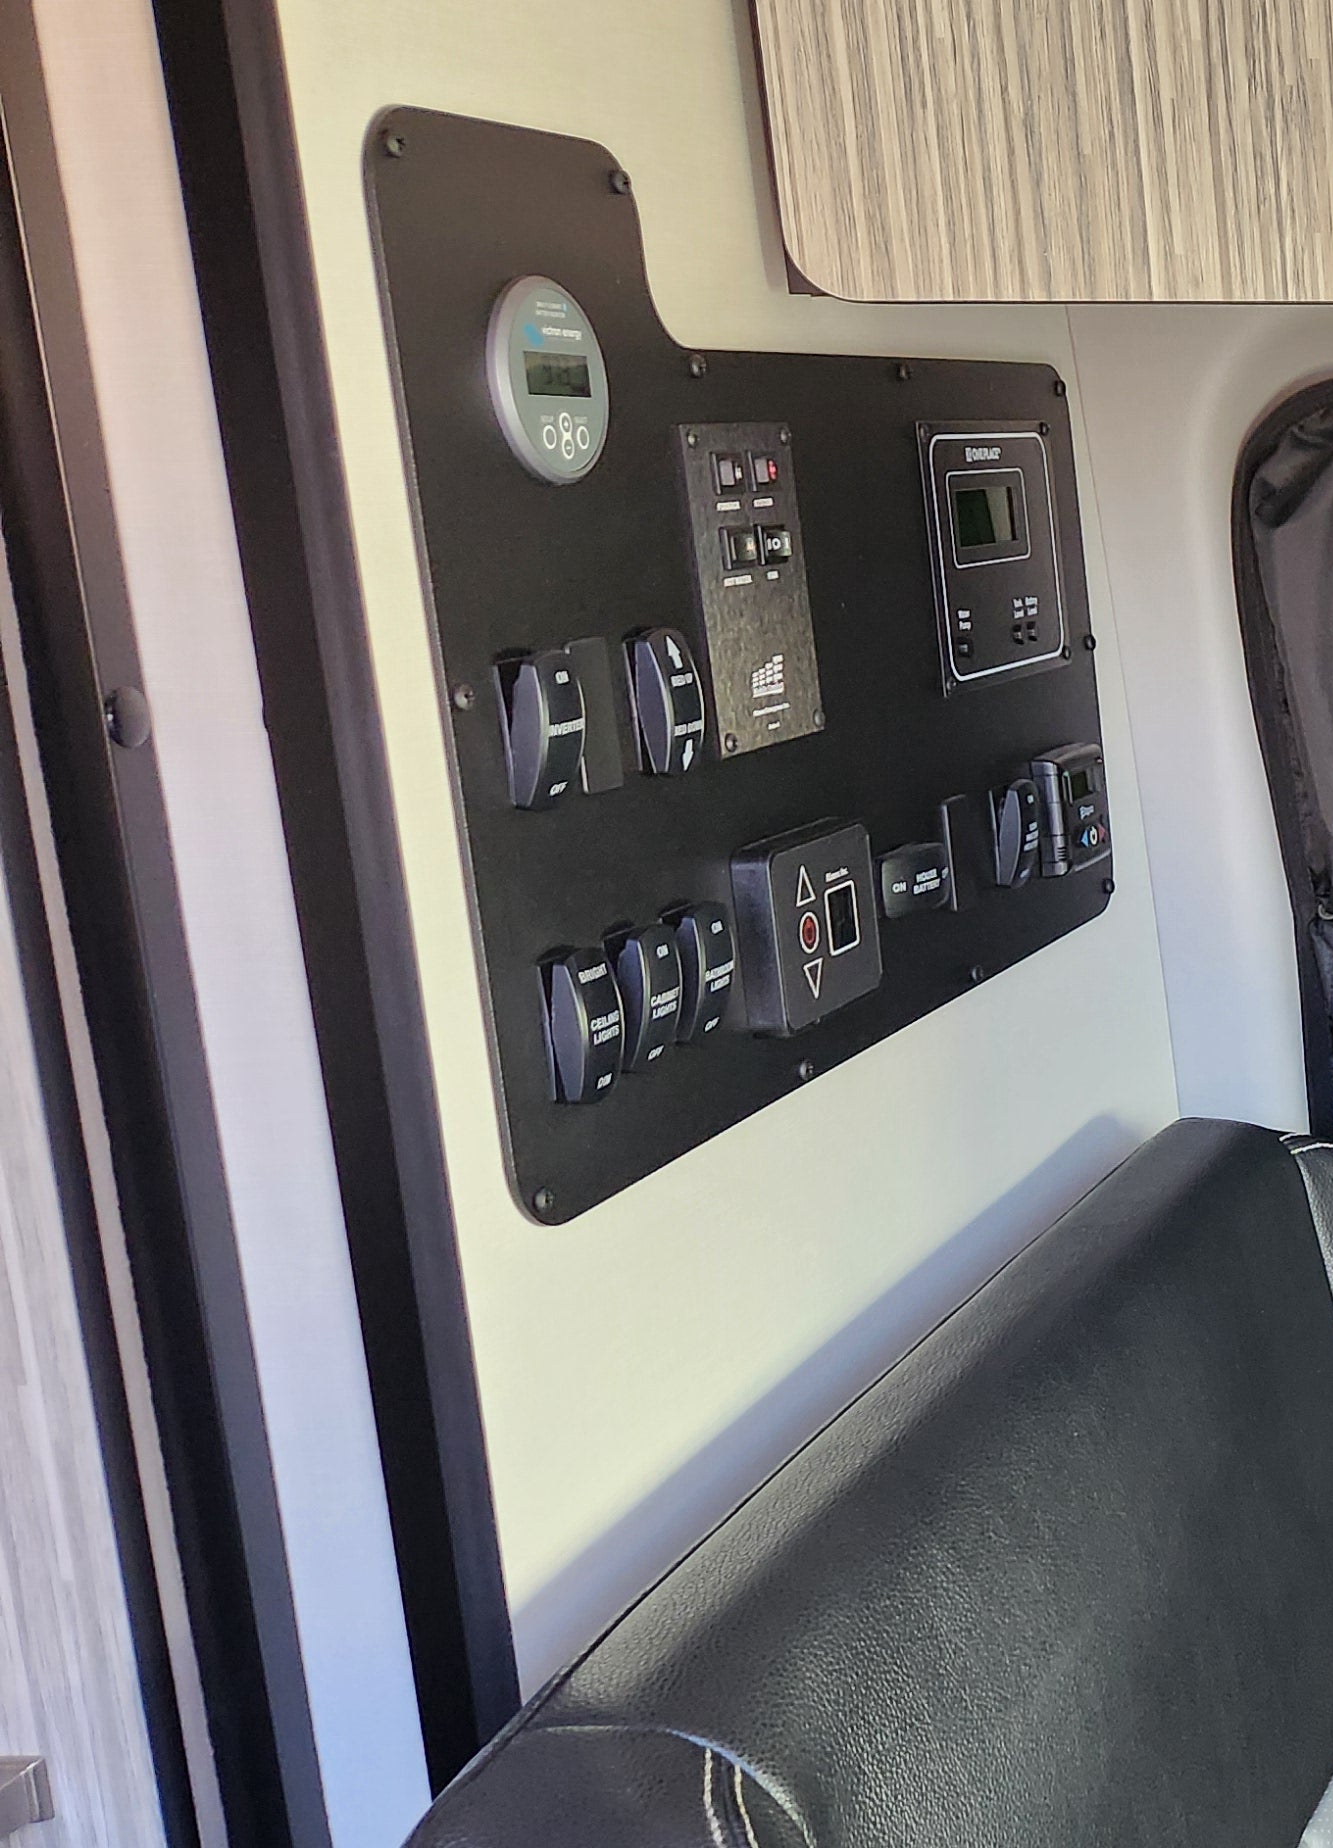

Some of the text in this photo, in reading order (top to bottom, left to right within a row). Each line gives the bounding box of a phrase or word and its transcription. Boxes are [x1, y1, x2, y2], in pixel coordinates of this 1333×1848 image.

[549, 781, 569, 797] OFF
[892, 881, 907, 894] ON
[656, 944, 669, 959] ON
[578, 962, 607, 984] BRIGHT
[650, 986, 680, 1008] CABINET
[652, 1000, 677, 1020] LIGHTS
[590, 1009, 620, 1032] CEILING
[593, 1024, 620, 1046] LIGHTS
[648, 1044, 665, 1061] OFF
